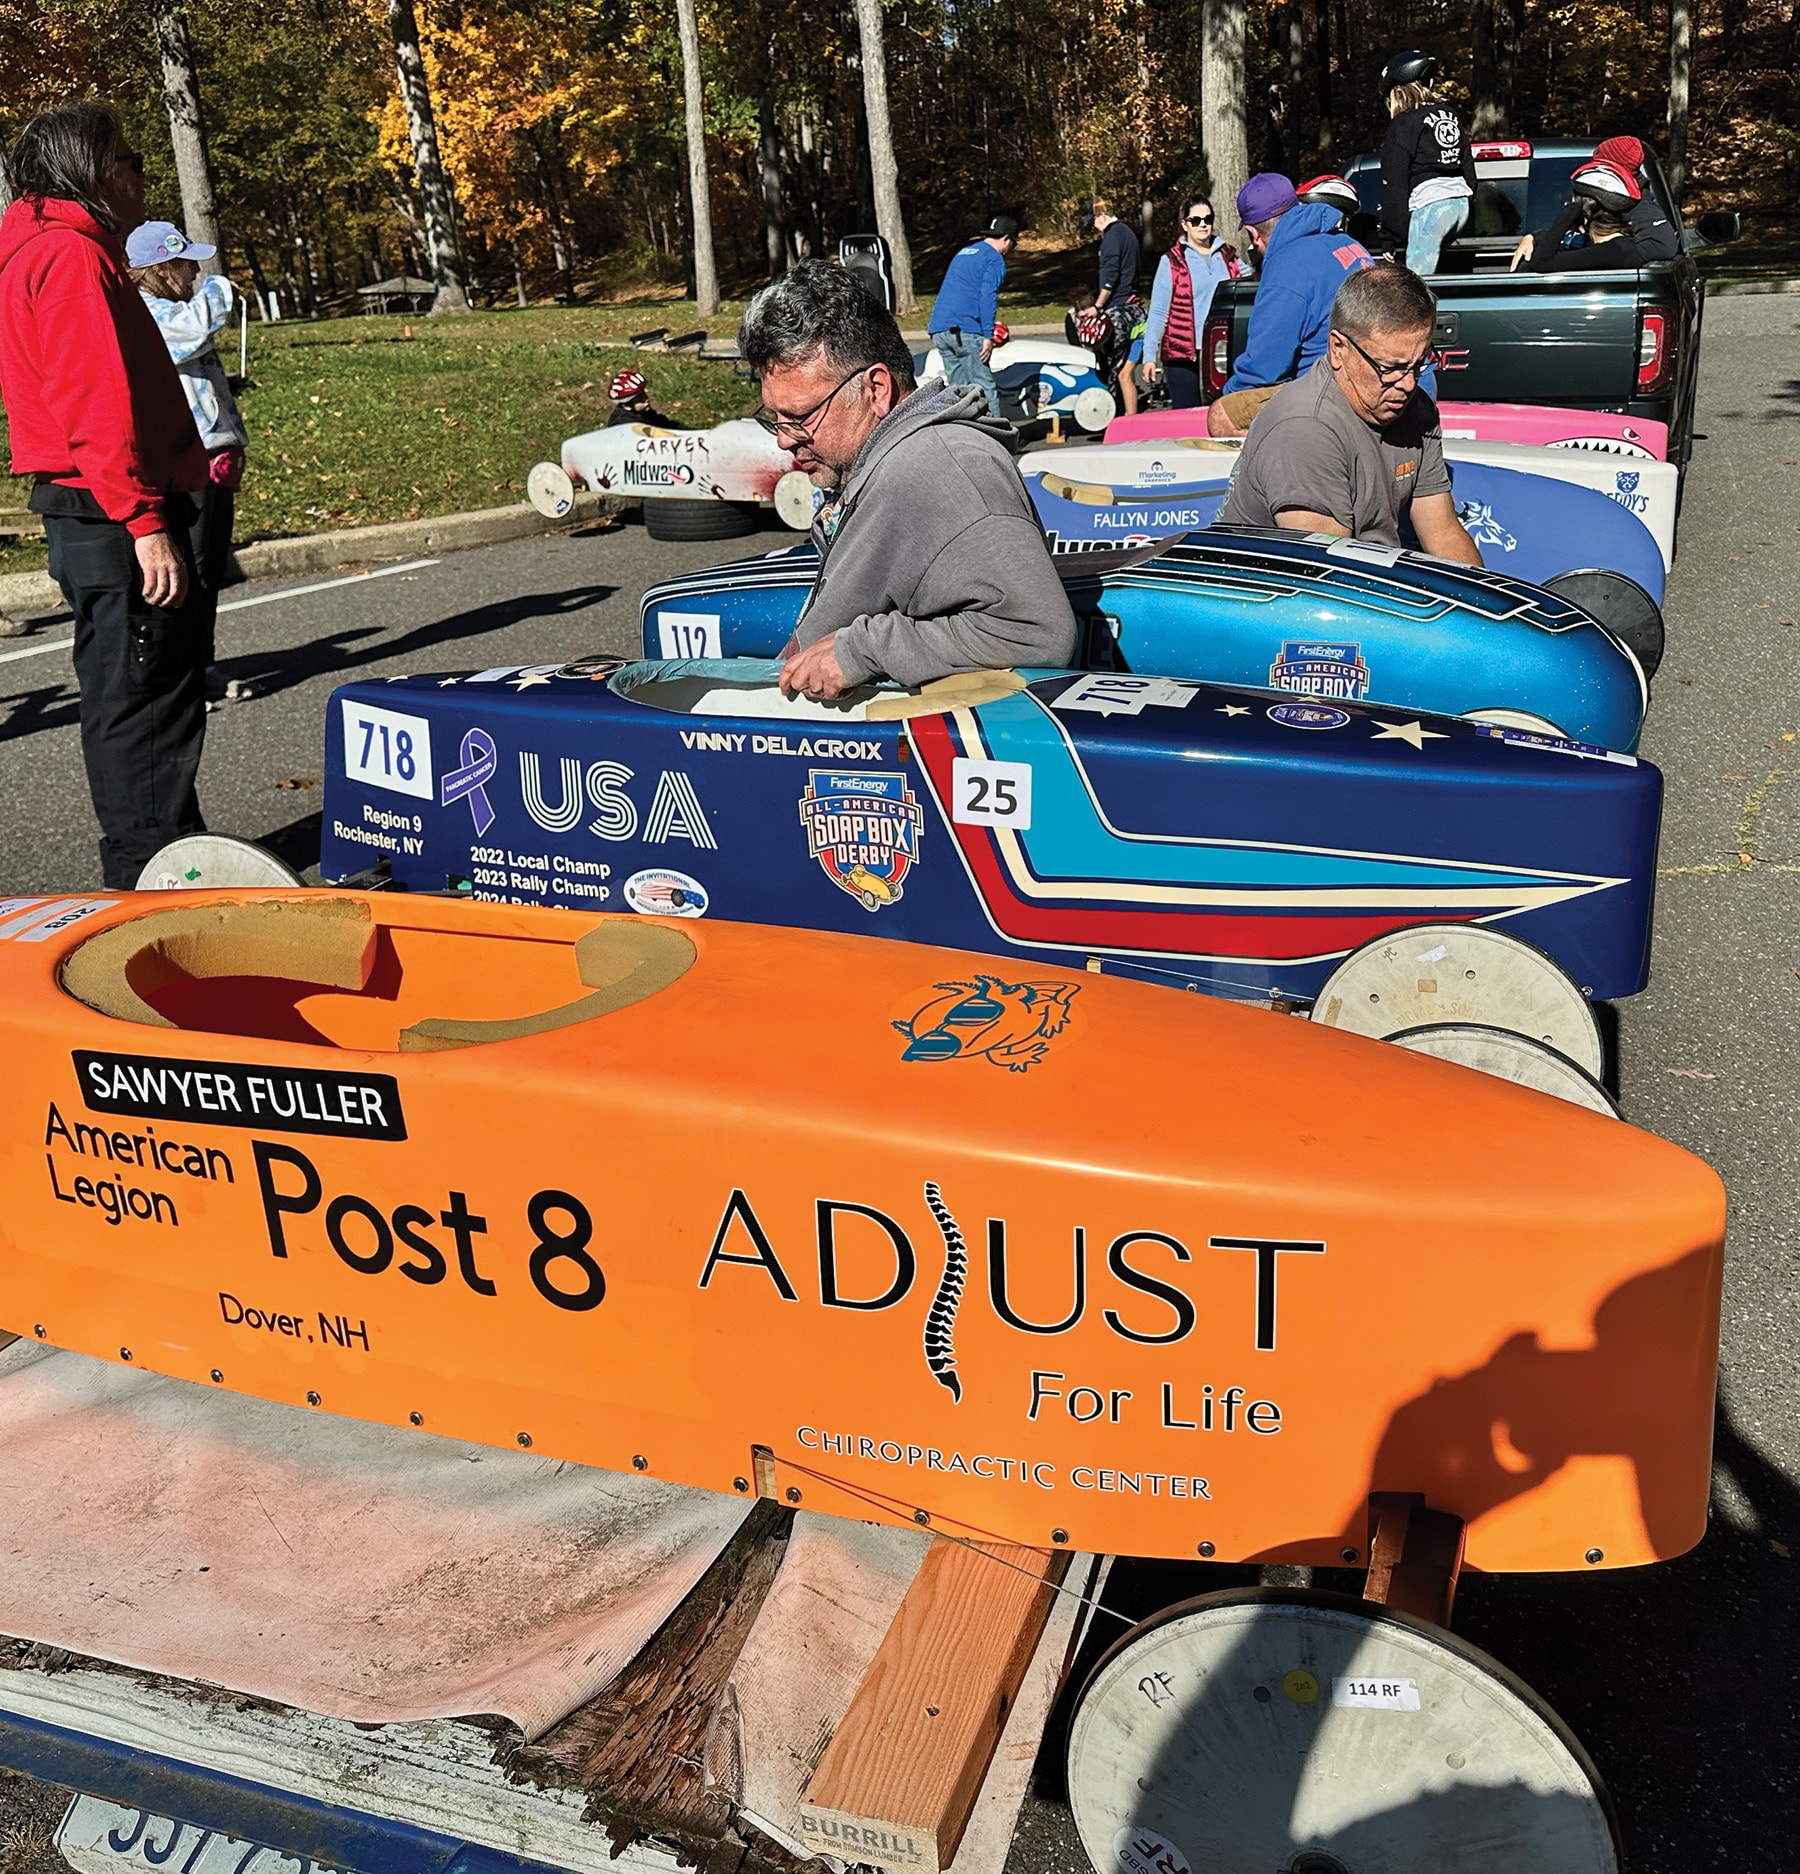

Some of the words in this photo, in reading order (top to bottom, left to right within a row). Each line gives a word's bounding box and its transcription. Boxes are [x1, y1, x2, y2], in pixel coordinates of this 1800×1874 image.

[636, 437, 710, 456] CARVER
[1138, 471, 1177, 479] Marketing
[1093, 512, 1148, 528] FALLYN
[1151, 511, 1199, 527] JONES
[671, 625, 706, 660] 112
[1297, 645, 1346, 660] FirstEnergy
[1275, 663, 1364, 681] ALL-AMERICAN
[1280, 676, 1320, 695] SOAP
[1323, 677, 1356, 699] BOX
[358, 720, 416, 781] 718
[680, 731, 747, 752] VINNY
[751, 735, 883, 760] DELACROIX
[519, 751, 718, 850] USA
[830, 777, 889, 792] FirstEnergy
[966, 776, 1018, 816] 25
[363, 805, 410, 830] Region
[413, 815, 422, 832] 9
[806, 800, 916, 821] ALL-AMERICAN
[333, 820, 400, 854] Rochester,
[403, 837, 424, 856] NY
[814, 814, 864, 847] SOAP
[867, 817, 910, 853] BOX
[470, 846, 505, 866] 2022
[508, 850, 549, 871] Local
[553, 856, 611, 880] Champ
[837, 844, 890, 866] DERBY
[473, 868, 508, 887] 2023
[510, 872, 548, 895] Rally
[552, 877, 610, 901] Champ
[88, 1062, 242, 1112] SAWYER
[246, 1076, 389, 1127] FULLER
[45, 1101, 236, 1184] American
[46, 1153, 180, 1226] Legion
[251, 1139, 497, 1297] Post
[527, 1189, 606, 1312] 8
[1027, 1369, 1133, 1423] For
[1160, 1383, 1283, 1435] Life
[796, 1425, 1058, 1490] CHIROPRACTIC
[1071, 1466, 1213, 1500] CENTER
[1349, 1682, 1378, 1696] 114
[1381, 1684, 1401, 1697] RF
[801, 1814, 923, 1857] BURRILL
